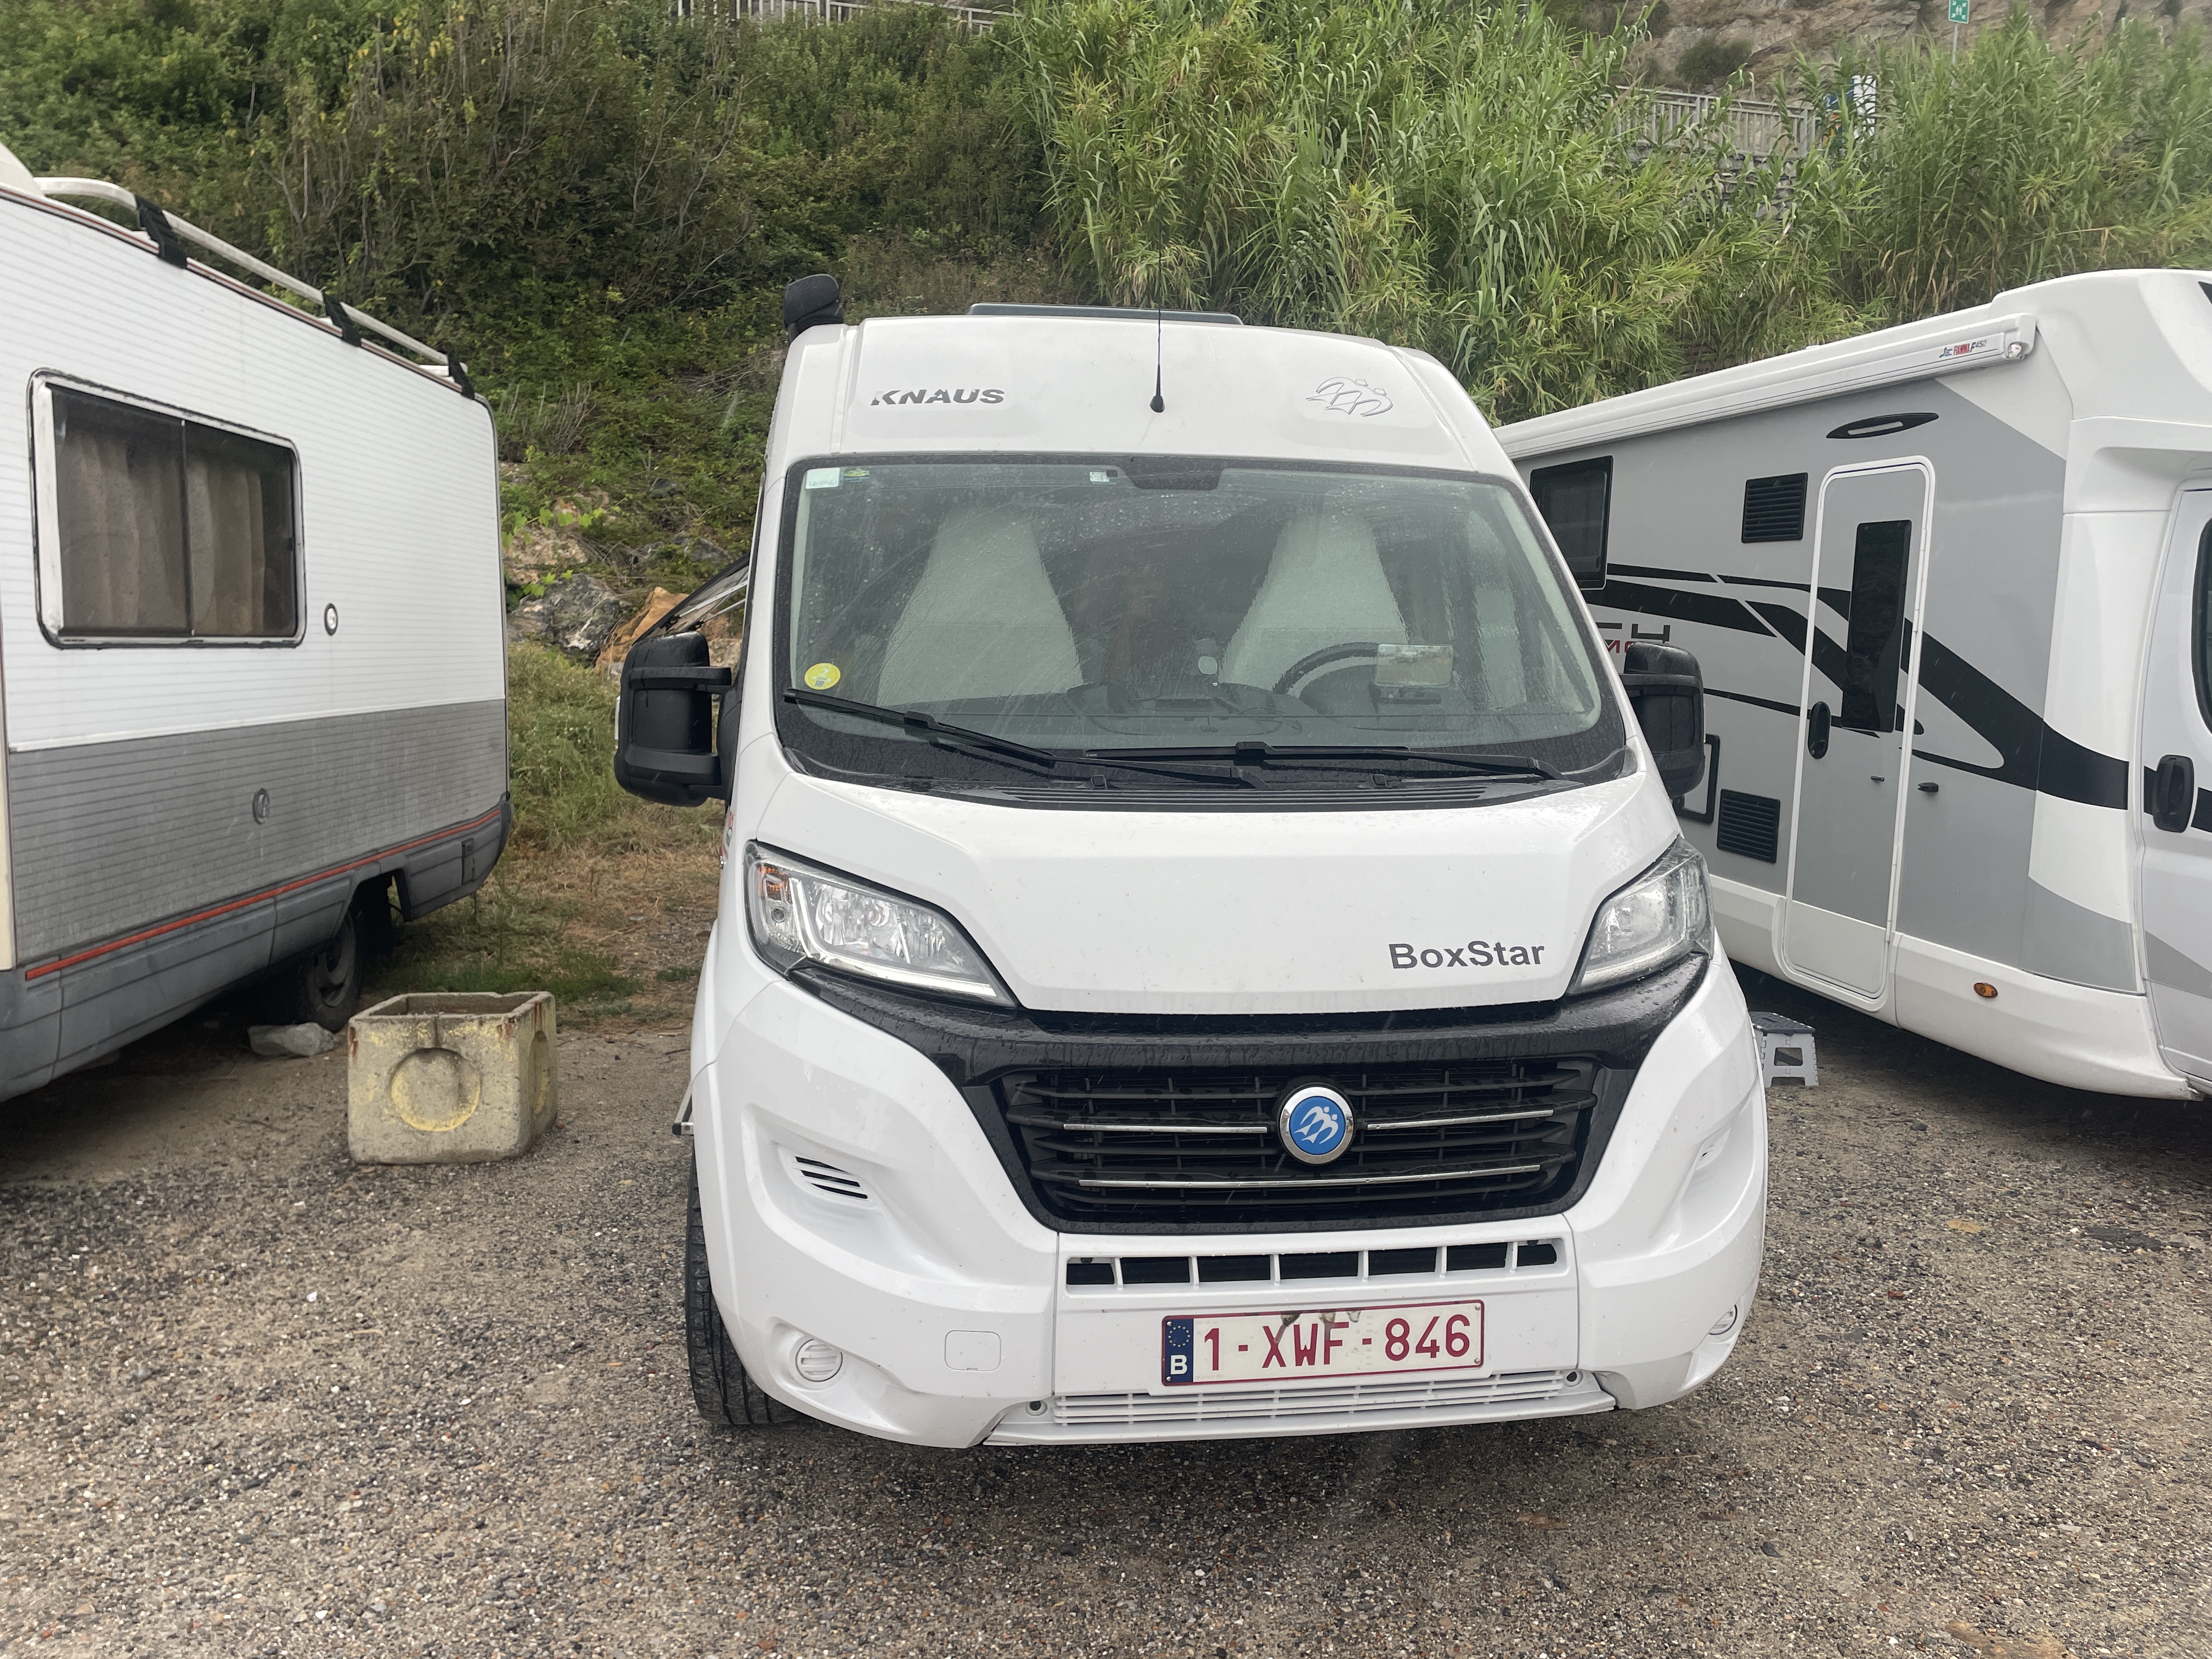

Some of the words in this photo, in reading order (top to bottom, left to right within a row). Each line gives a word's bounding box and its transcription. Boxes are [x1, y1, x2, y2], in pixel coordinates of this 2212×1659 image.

[870, 388, 1005, 406] KNAUS
[1388, 940, 1545, 969] BoxStar
[1170, 1355, 1188, 1375] B
